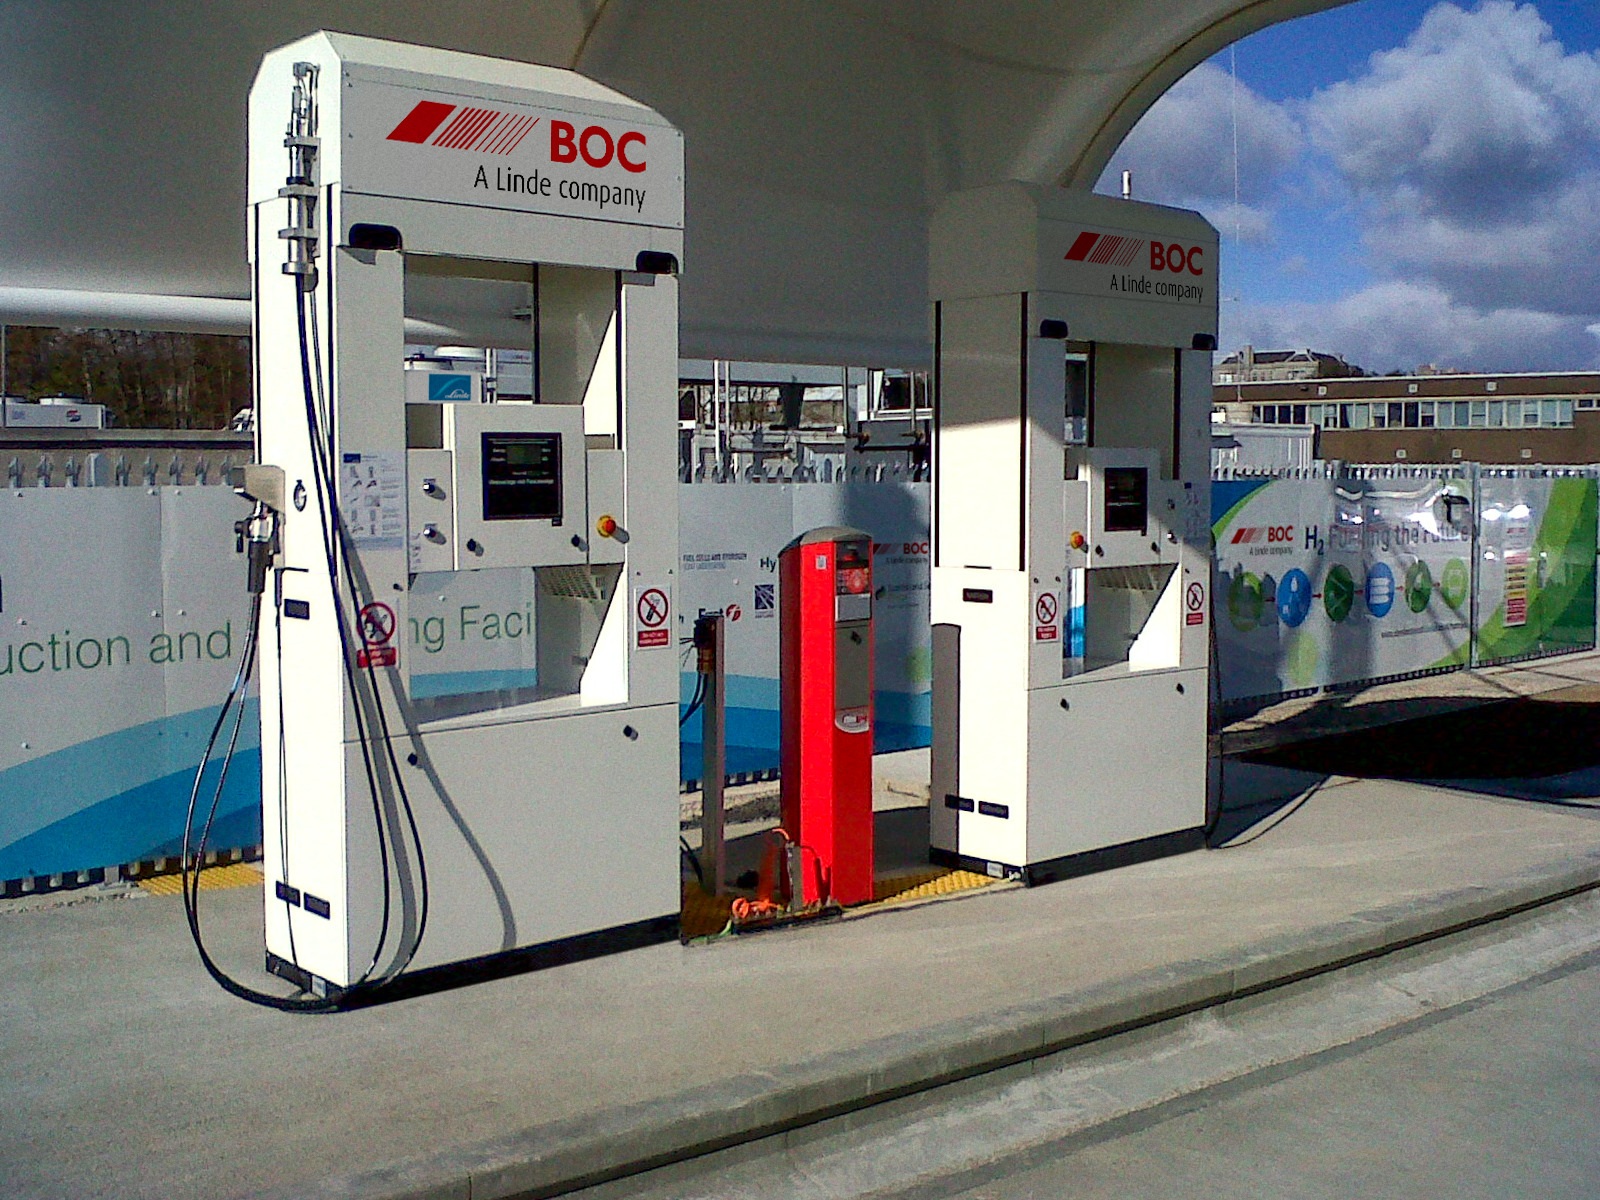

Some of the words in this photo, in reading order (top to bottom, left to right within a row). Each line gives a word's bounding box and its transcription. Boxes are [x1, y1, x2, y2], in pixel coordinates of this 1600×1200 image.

[550, 119, 647, 173] BOC
[473, 165, 489, 189] A
[496, 167, 551, 197] Linde
[559, 180, 647, 213] company
[1150, 241, 1203, 276] BOC
[1110, 274, 1119, 291] A
[1121, 275, 1152, 295] Linde
[1155, 282, 1203, 303] company
[903, 542, 929, 554] BOC
[1267, 525, 1294, 543] BOC
[150, 619, 232, 664] and
